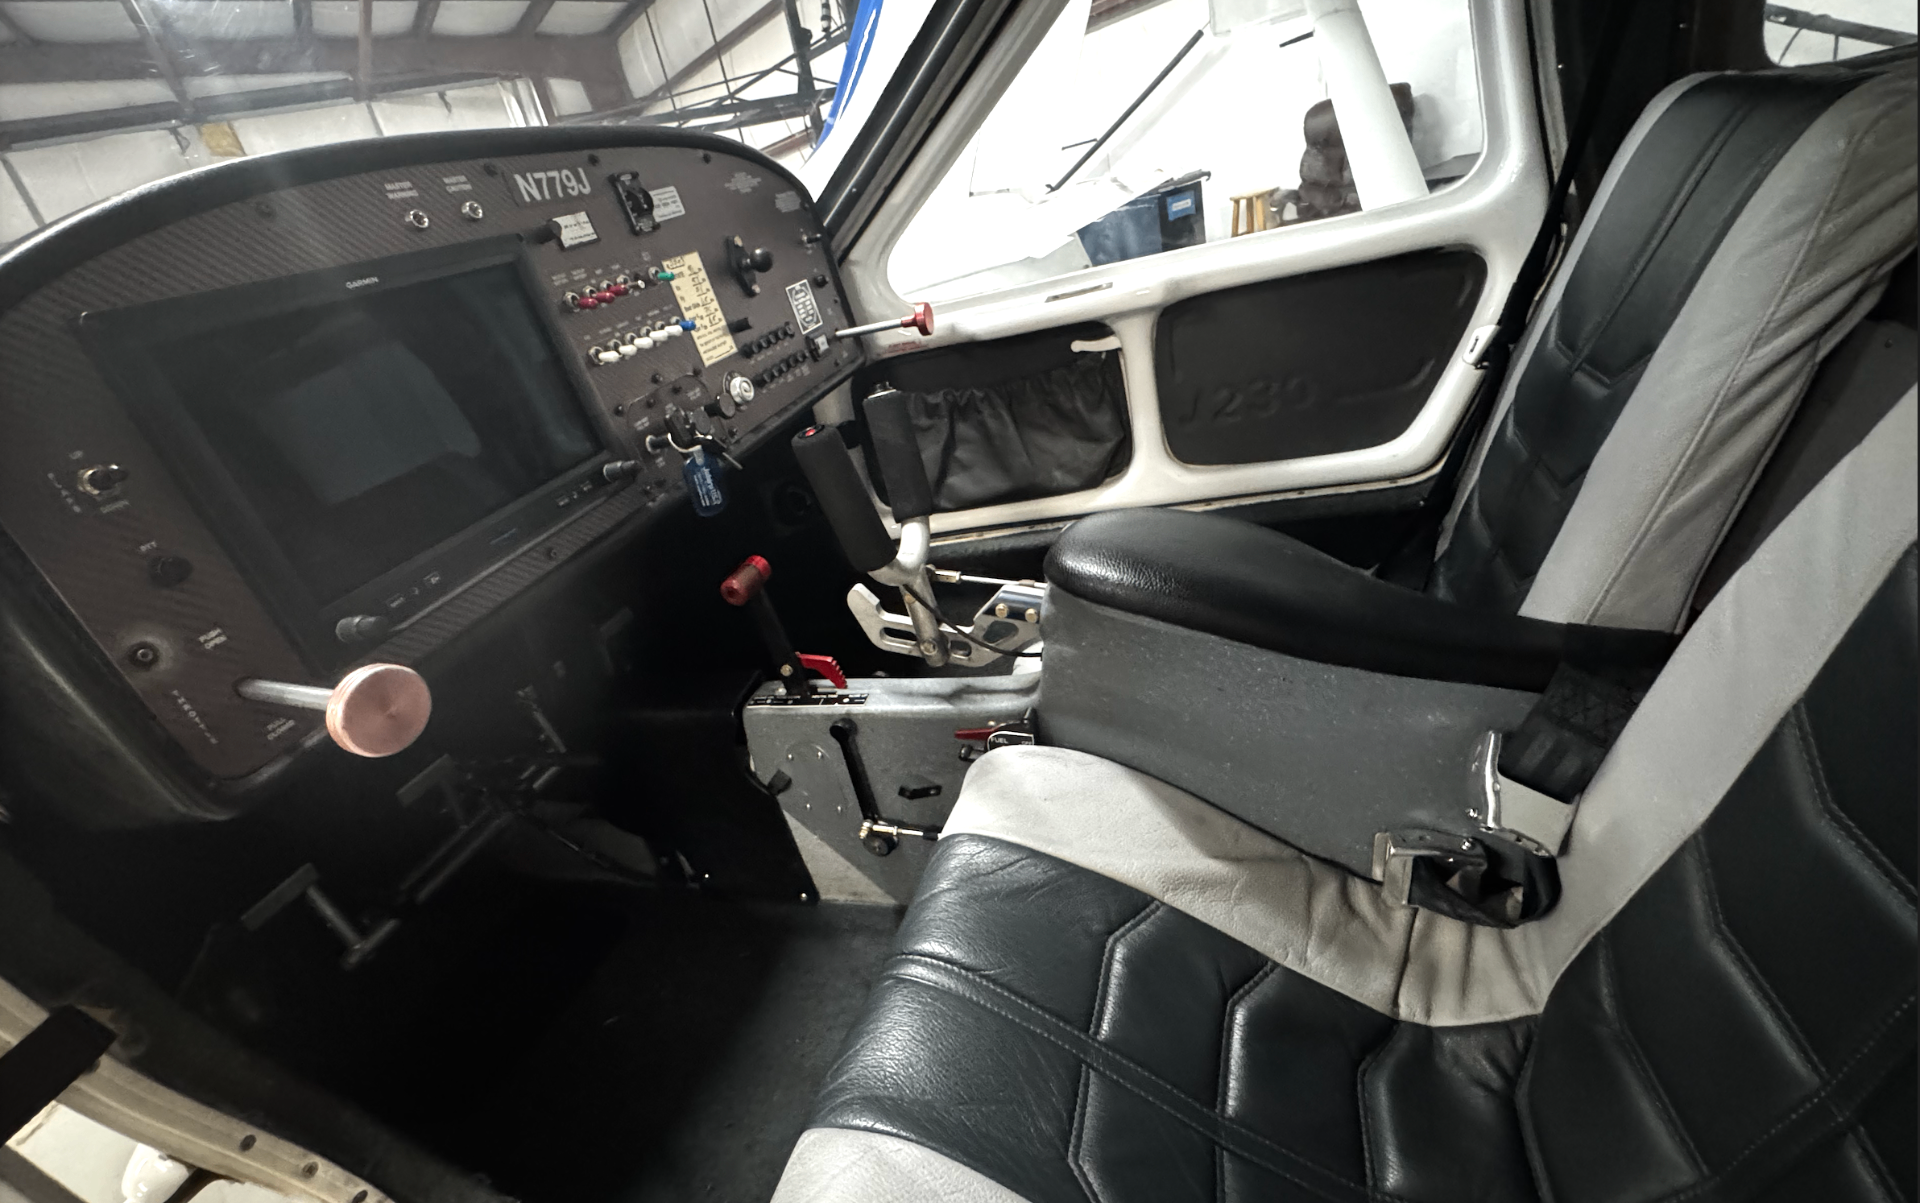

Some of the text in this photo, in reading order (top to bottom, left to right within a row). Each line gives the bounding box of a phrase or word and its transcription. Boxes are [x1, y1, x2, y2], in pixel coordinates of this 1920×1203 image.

[384, 181, 413, 191] MASTER
[514, 167, 591, 202] N779J
[345, 276, 379, 289] GARMIN
[990, 736, 1009, 744] FUEL
